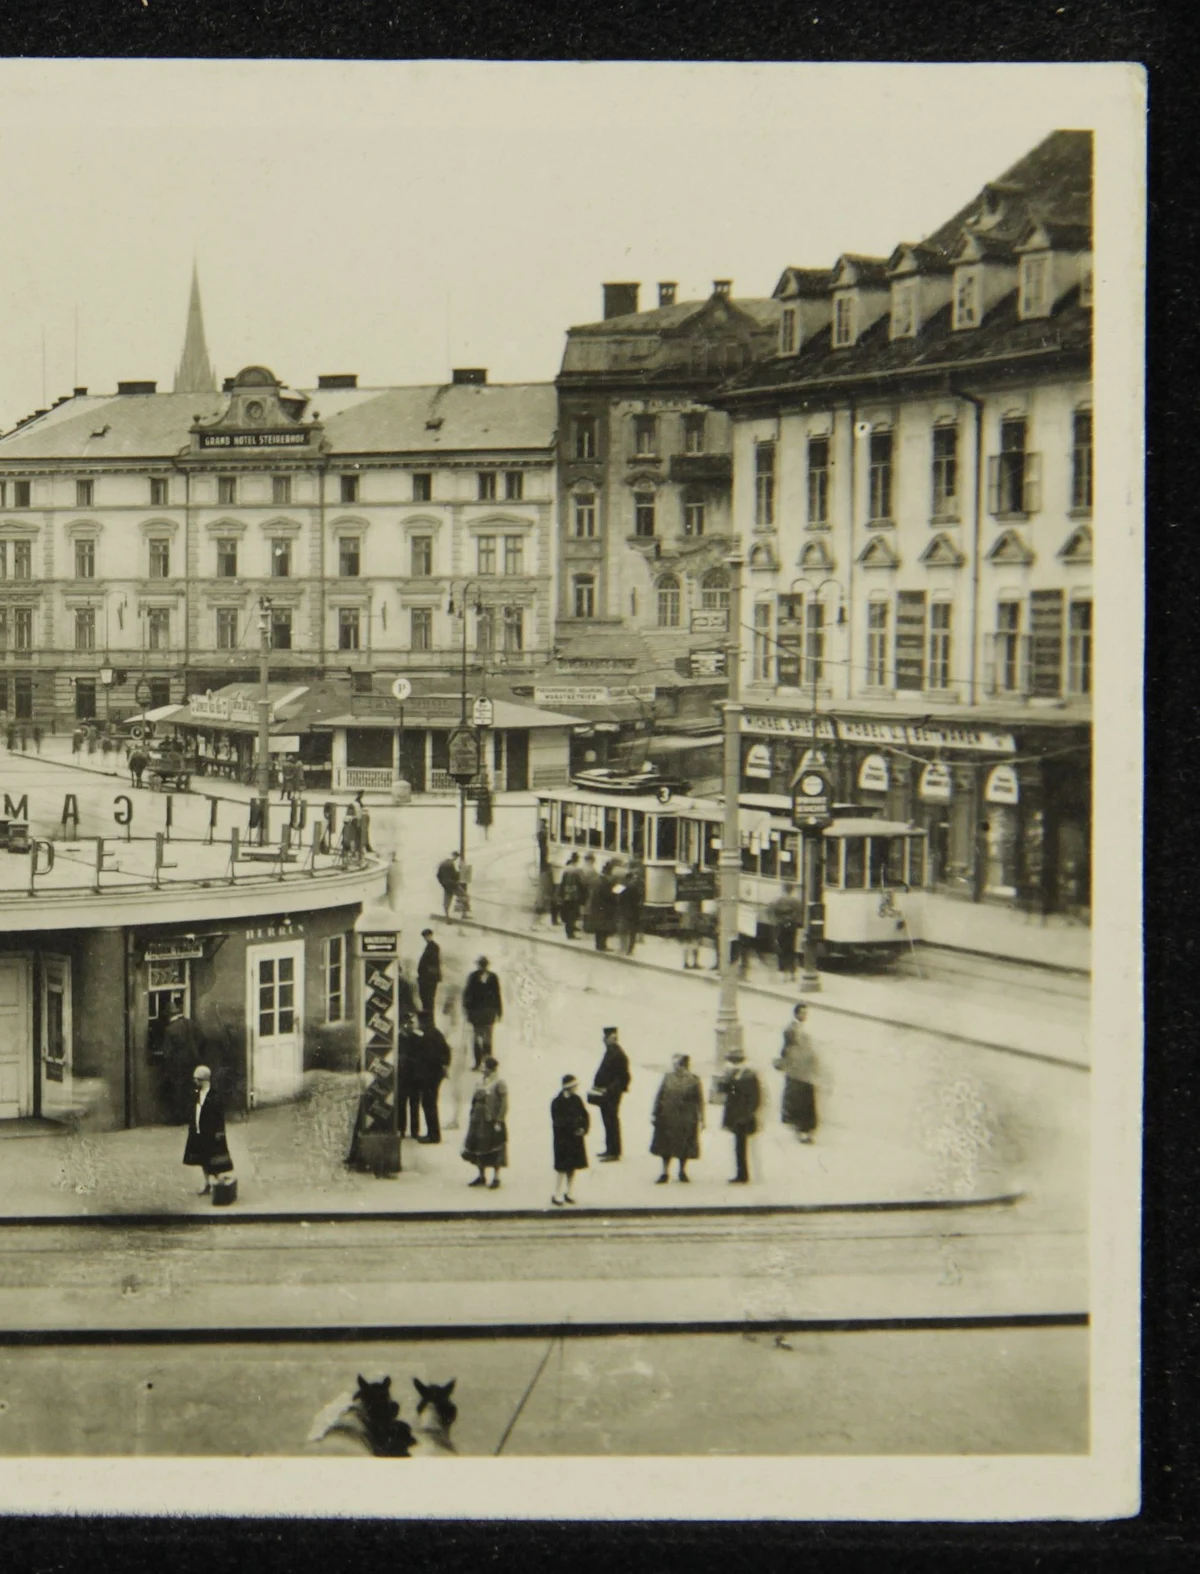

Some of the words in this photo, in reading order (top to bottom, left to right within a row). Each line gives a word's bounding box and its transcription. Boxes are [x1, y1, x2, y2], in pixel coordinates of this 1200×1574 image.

[205, 437, 230, 446] GRAND
[234, 435, 257, 445] HOTEL
[259, 434, 305, 444] STEIRERHOF
[660, 787, 670, 801] 3
